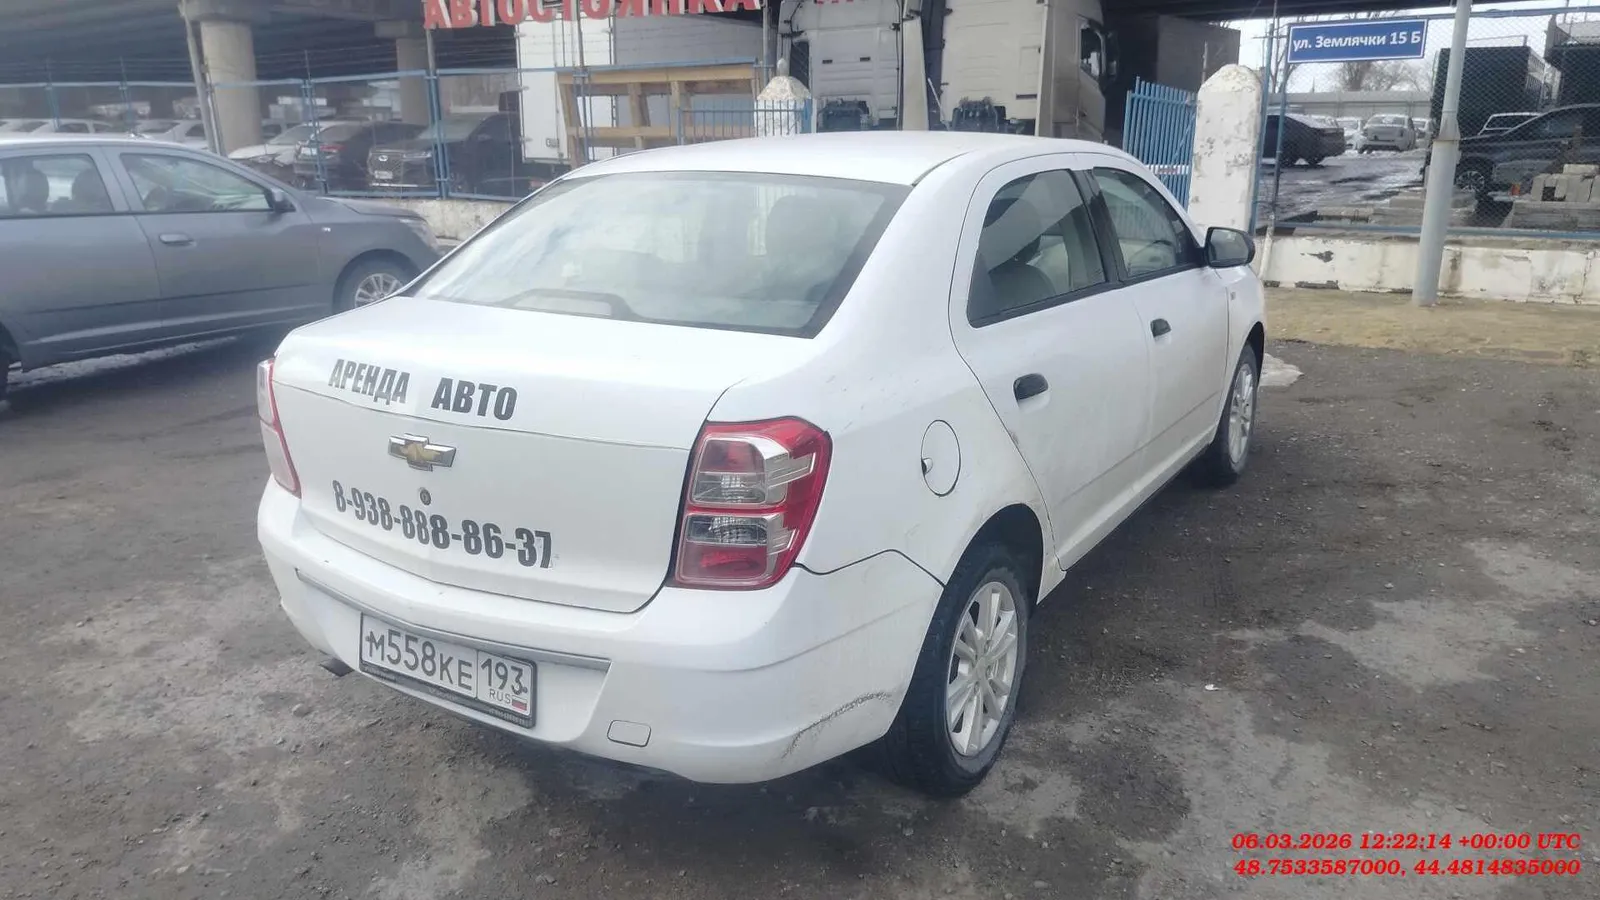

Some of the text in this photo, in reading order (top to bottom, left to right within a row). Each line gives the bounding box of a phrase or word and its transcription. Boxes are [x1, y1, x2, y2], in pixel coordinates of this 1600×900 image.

[424, 0, 761, 29] АВТОСТО
[1293, 30, 1421, 52] ул. Землячки 15 Б
[328, 358, 518, 421] АРЕНДА АВТО
[332, 480, 552, 569] 8-938-888-86-37
[369, 629, 524, 696] М558КЕ 193
[489, 688, 511, 704] RUS
